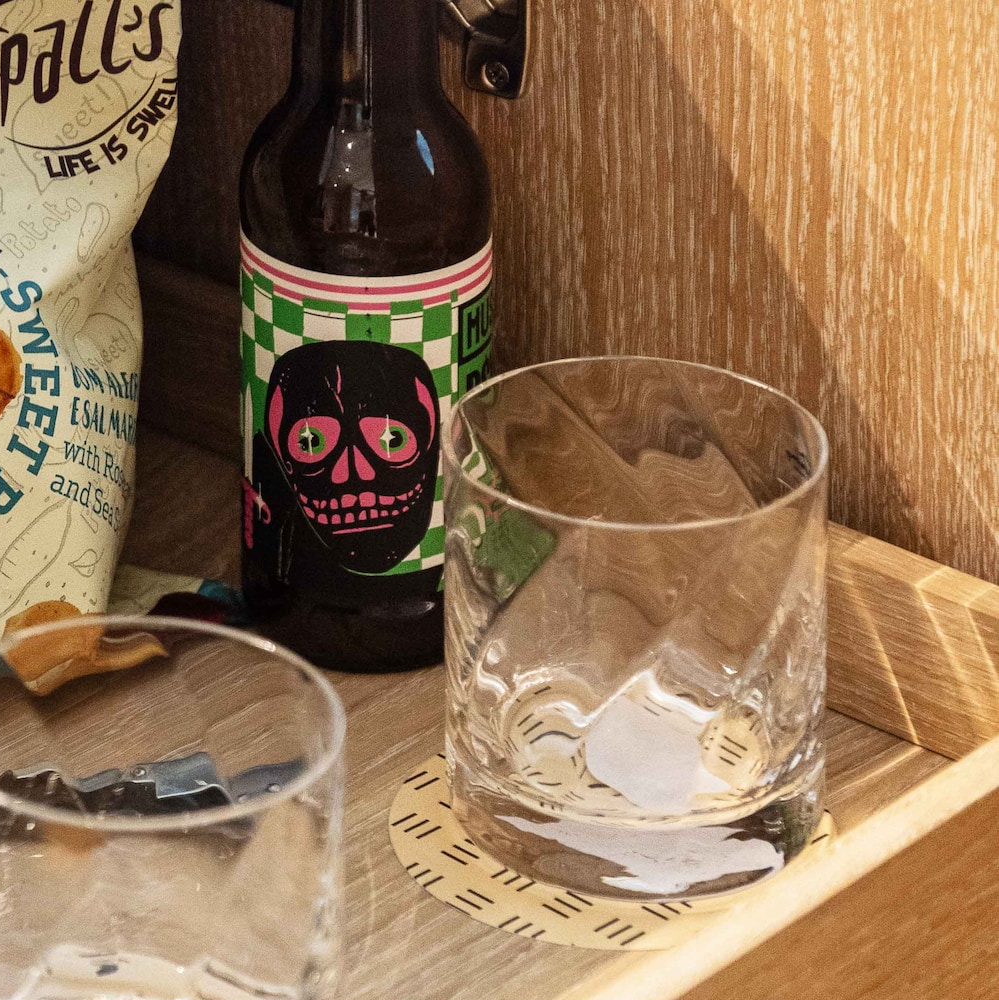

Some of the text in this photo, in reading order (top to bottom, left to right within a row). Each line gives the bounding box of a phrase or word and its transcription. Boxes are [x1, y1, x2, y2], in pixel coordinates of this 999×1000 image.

[44, 149, 100, 178] LIFE
[99, 134, 128, 165] IS
[0, 197, 82, 259] Potato
[0, 280, 60, 477] SWEET
[70, 396, 81, 426] E
[82, 400, 105, 435] SAL
[63, 440, 101, 474] with
[50, 474, 92, 508] and
